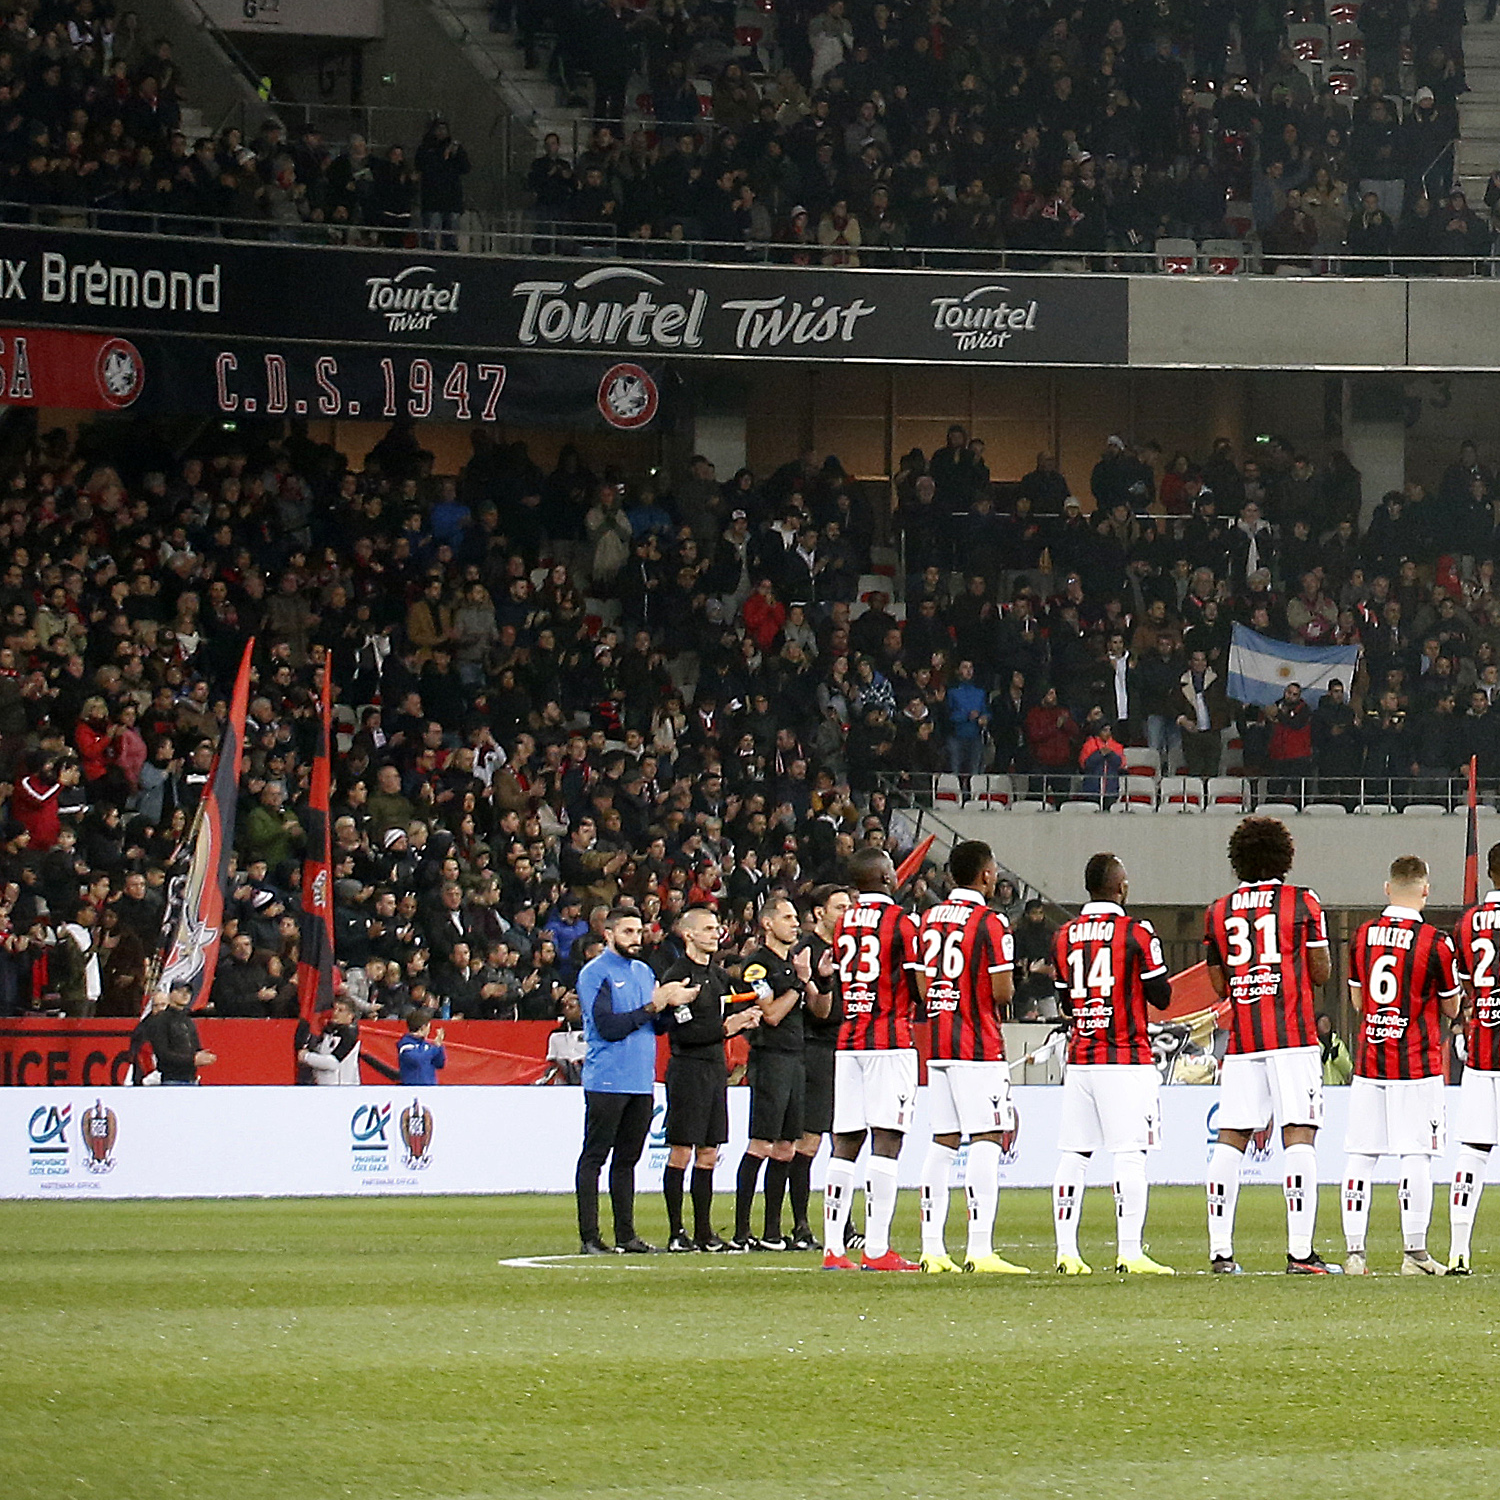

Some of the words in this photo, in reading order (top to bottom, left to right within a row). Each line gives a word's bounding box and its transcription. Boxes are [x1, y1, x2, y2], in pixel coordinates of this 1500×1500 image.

[42, 252, 220, 313] Brémond
[366, 276, 460, 314] Tourtel
[384, 312, 437, 333] Twist
[511, 278, 708, 349] Tourtel
[721, 295, 877, 351] Twist
[931, 298, 1038, 332] Tourtel
[953, 331, 1012, 352] Twist
[1231, 890, 1275, 911] DANTE
[1068, 921, 1115, 944] GANAGO
[1224, 913, 1282, 967] 31
[1367, 926, 1414, 950] WALTER
[837, 934, 880, 982] 23
[922, 929, 965, 979] 26
[1067, 947, 1115, 999] 14
[1230, 972, 1281, 986] mutuelles
[1232, 985, 1248, 997] du
[1248, 983, 1278, 996] soleil
[1369, 954, 1397, 1005] 6
[1376, 1026, 1404, 1039] soleil
